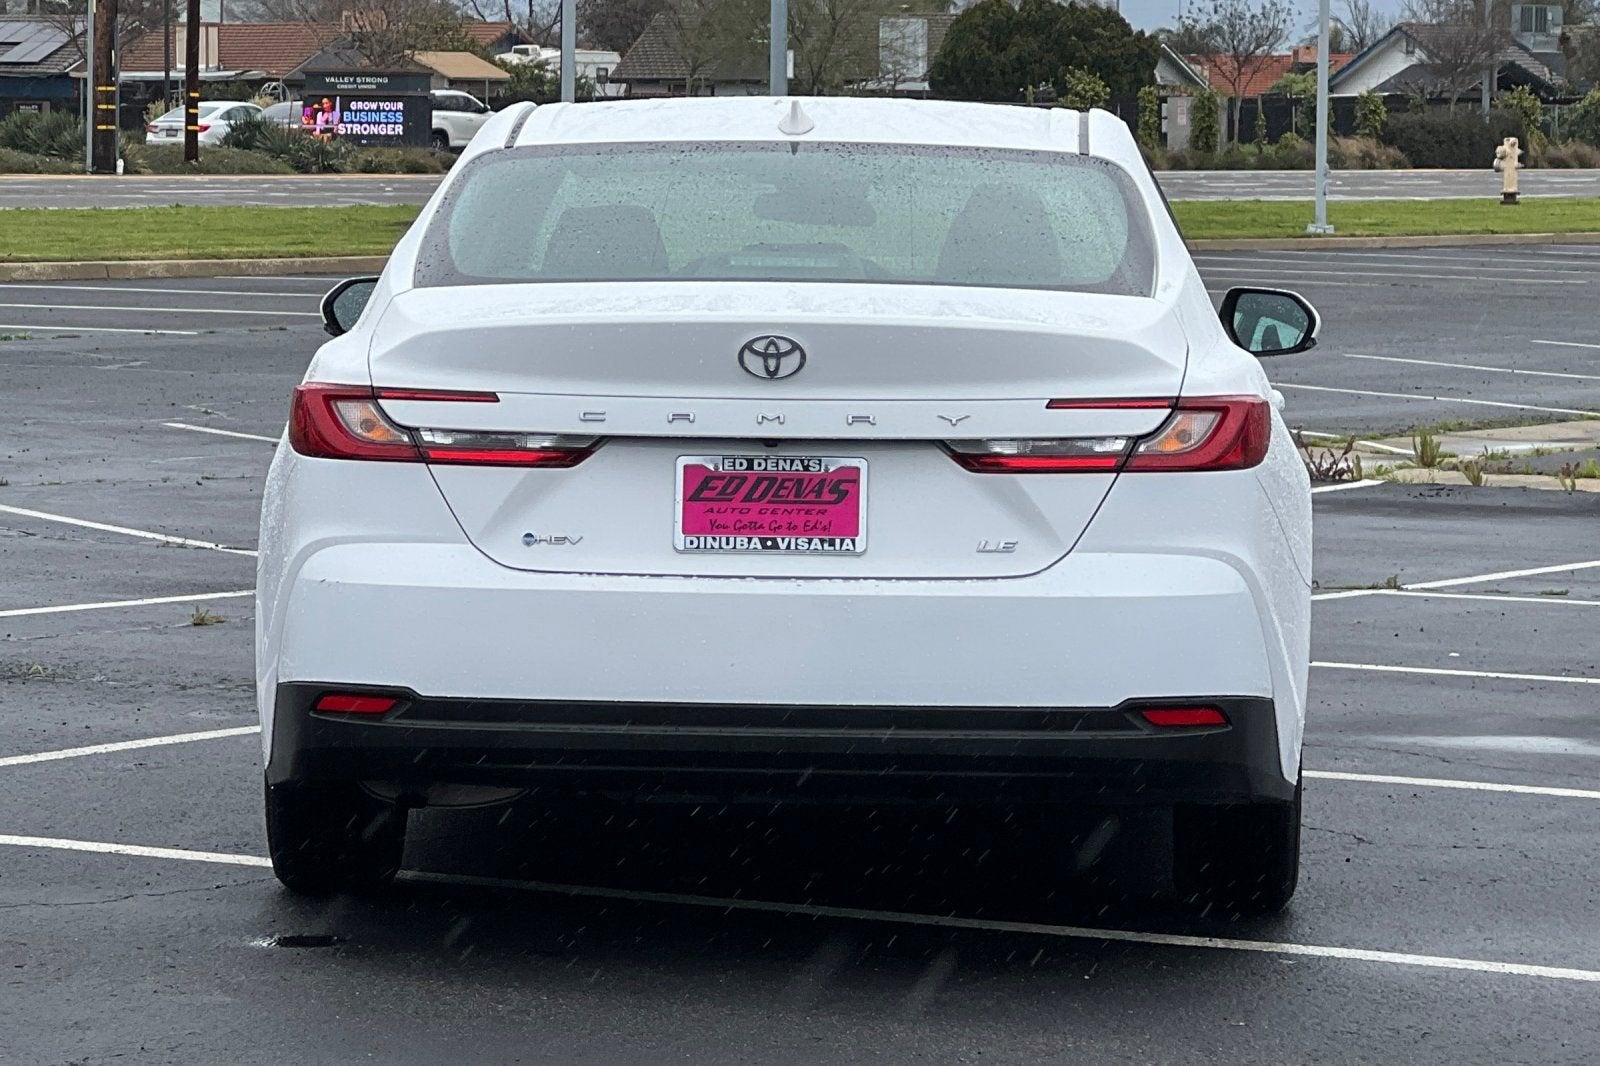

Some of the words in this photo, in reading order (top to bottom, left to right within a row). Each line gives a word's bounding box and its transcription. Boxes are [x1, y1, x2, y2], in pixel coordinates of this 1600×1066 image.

[350, 101, 378, 110] GROW
[379, 101, 404, 111] YOUR
[343, 111, 404, 123] BUSINESS
[337, 123, 404, 135] STRONGER
[579, 410, 970, 427] CAMRY
[723, 458, 748, 471] ED
[753, 458, 821, 472] DENA'S
[687, 475, 748, 502] ED
[740, 476, 857, 505] DENA'S
[758, 507, 828, 515] CENTER
[709, 519, 729, 531] You
[733, 519, 765, 531] Gotta
[768, 519, 783, 532] Go
[786, 521, 798, 531] to
[803, 519, 832, 532] Ed's!
[685, 537, 762, 550] DINUBA
[776, 538, 856, 551] VISALIA
[976, 540, 1018, 553] LE
